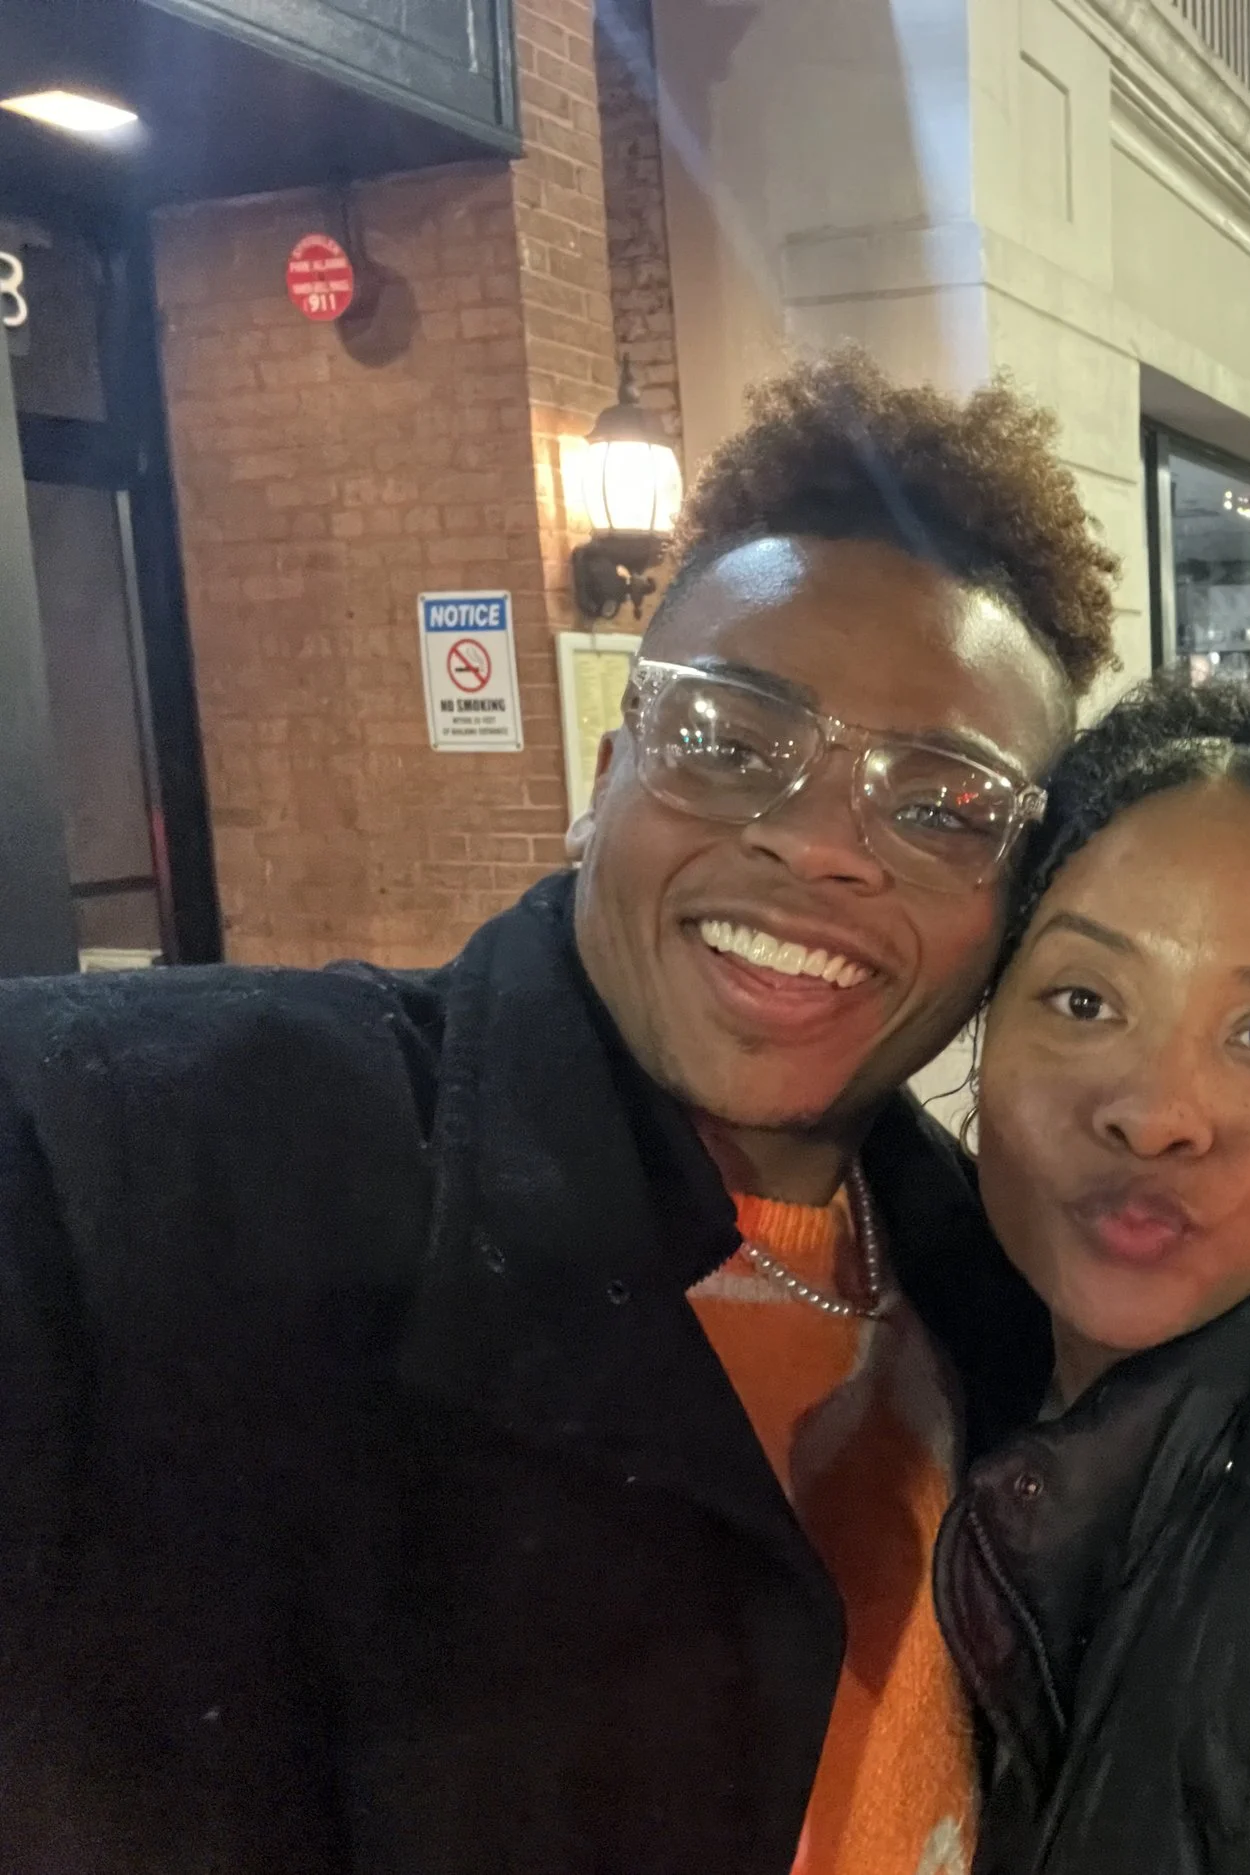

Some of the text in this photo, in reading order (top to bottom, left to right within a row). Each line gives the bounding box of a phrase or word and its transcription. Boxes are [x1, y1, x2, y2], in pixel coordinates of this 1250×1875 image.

[308, 293, 336, 312] 911
[429, 603, 500, 628] NOTICE
[440, 698, 506, 712] NO SMOKING
